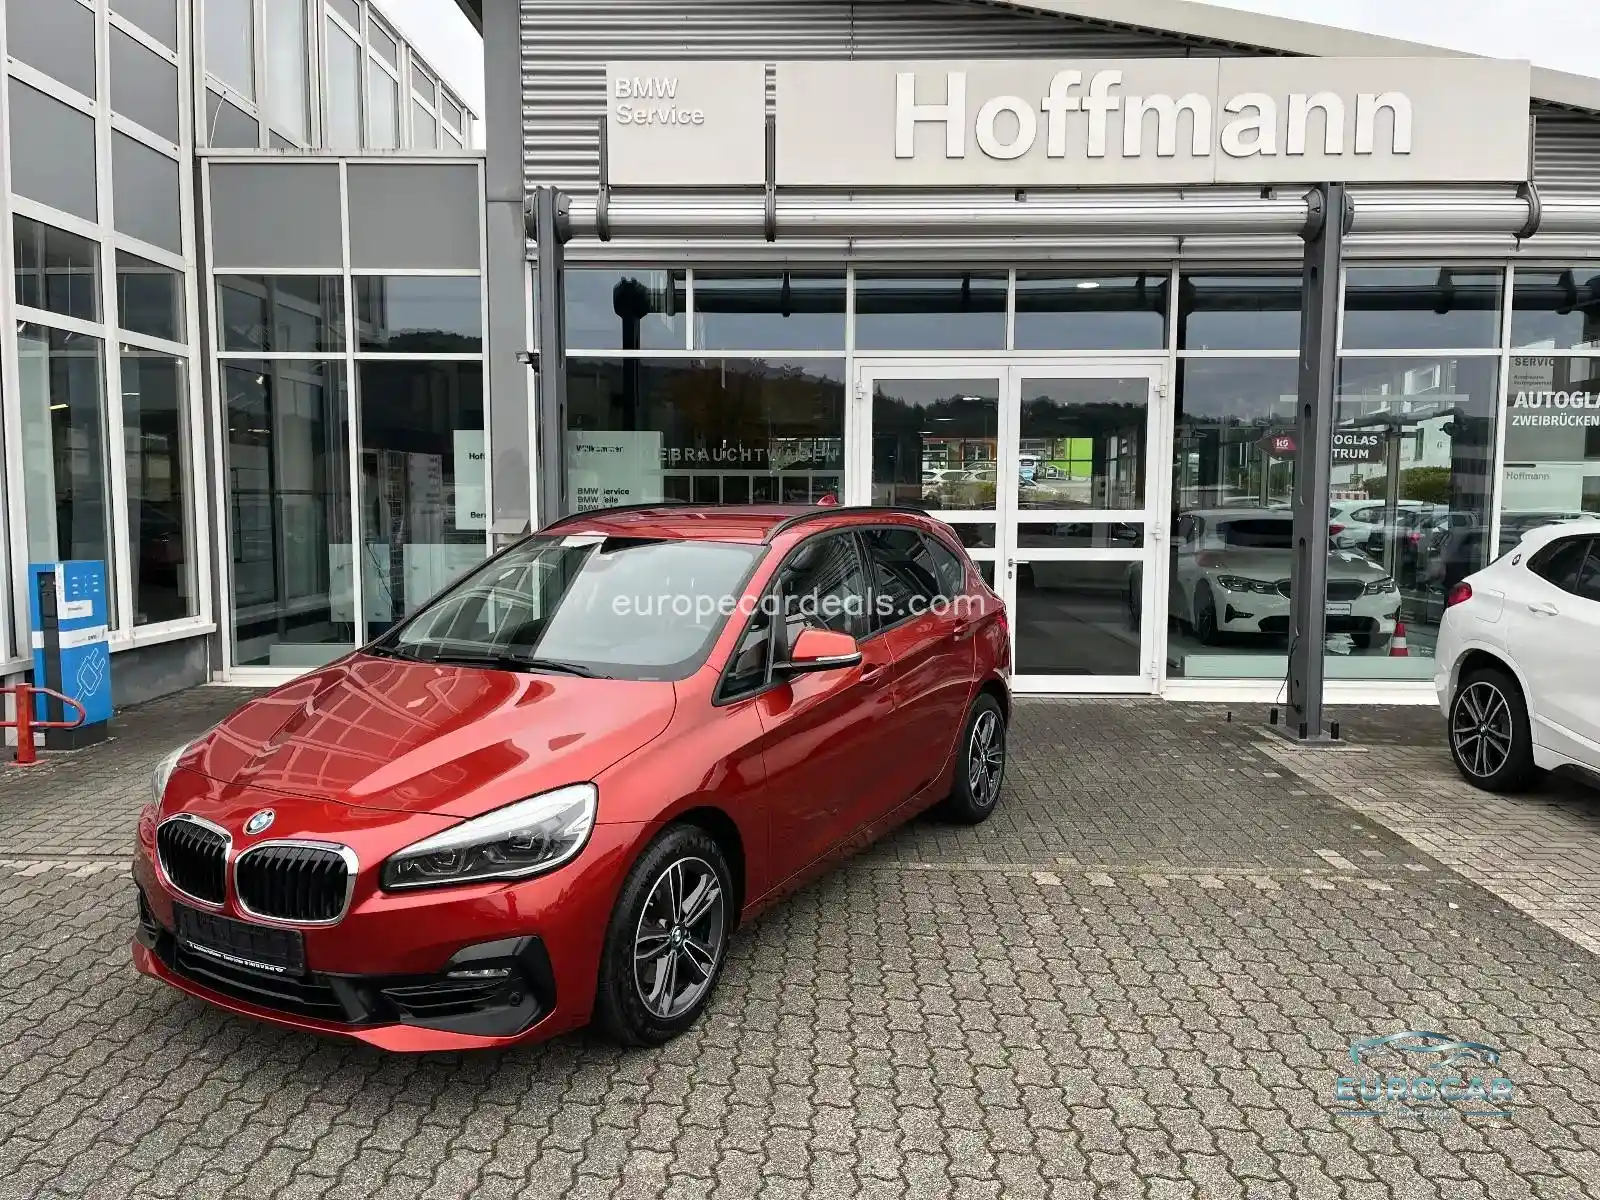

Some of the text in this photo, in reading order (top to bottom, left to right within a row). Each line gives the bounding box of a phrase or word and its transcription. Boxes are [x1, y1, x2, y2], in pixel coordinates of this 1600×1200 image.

[615, 77, 678, 98] BMW
[616, 104, 705, 124] Service
[894, 70, 1413, 160] Hoffmann
[1512, 412, 1600, 426] ZWEIBRÜCKEN
[1332, 435, 1378, 445] OGLAS
[657, 448, 837, 462] EBRAUCHTWAGEN
